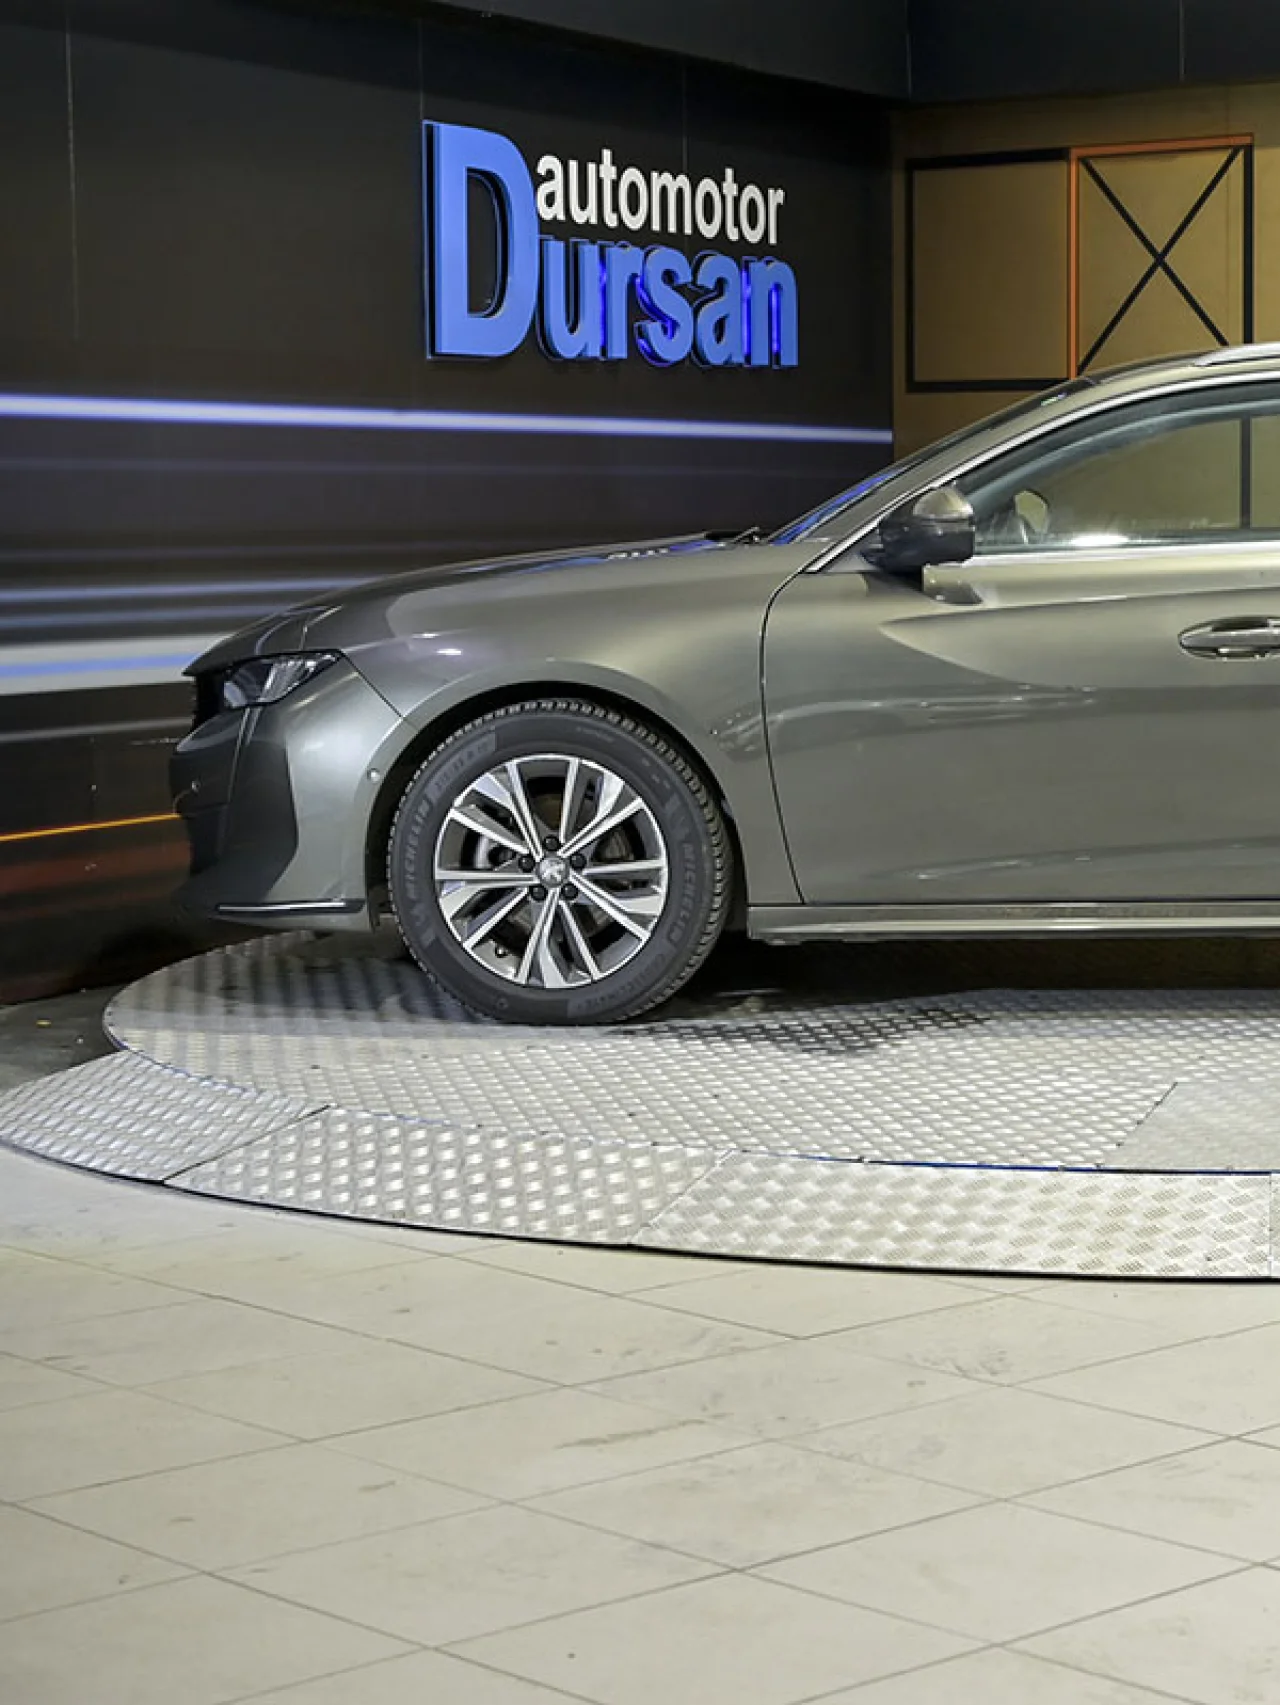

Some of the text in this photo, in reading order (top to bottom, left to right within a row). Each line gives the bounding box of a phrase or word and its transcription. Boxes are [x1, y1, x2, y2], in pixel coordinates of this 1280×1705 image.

[422, 119, 798, 368] Dursan
[535, 148, 785, 245] automotor
[404, 798, 431, 900] MICHELIN
[667, 842, 697, 946] MICHELIN
